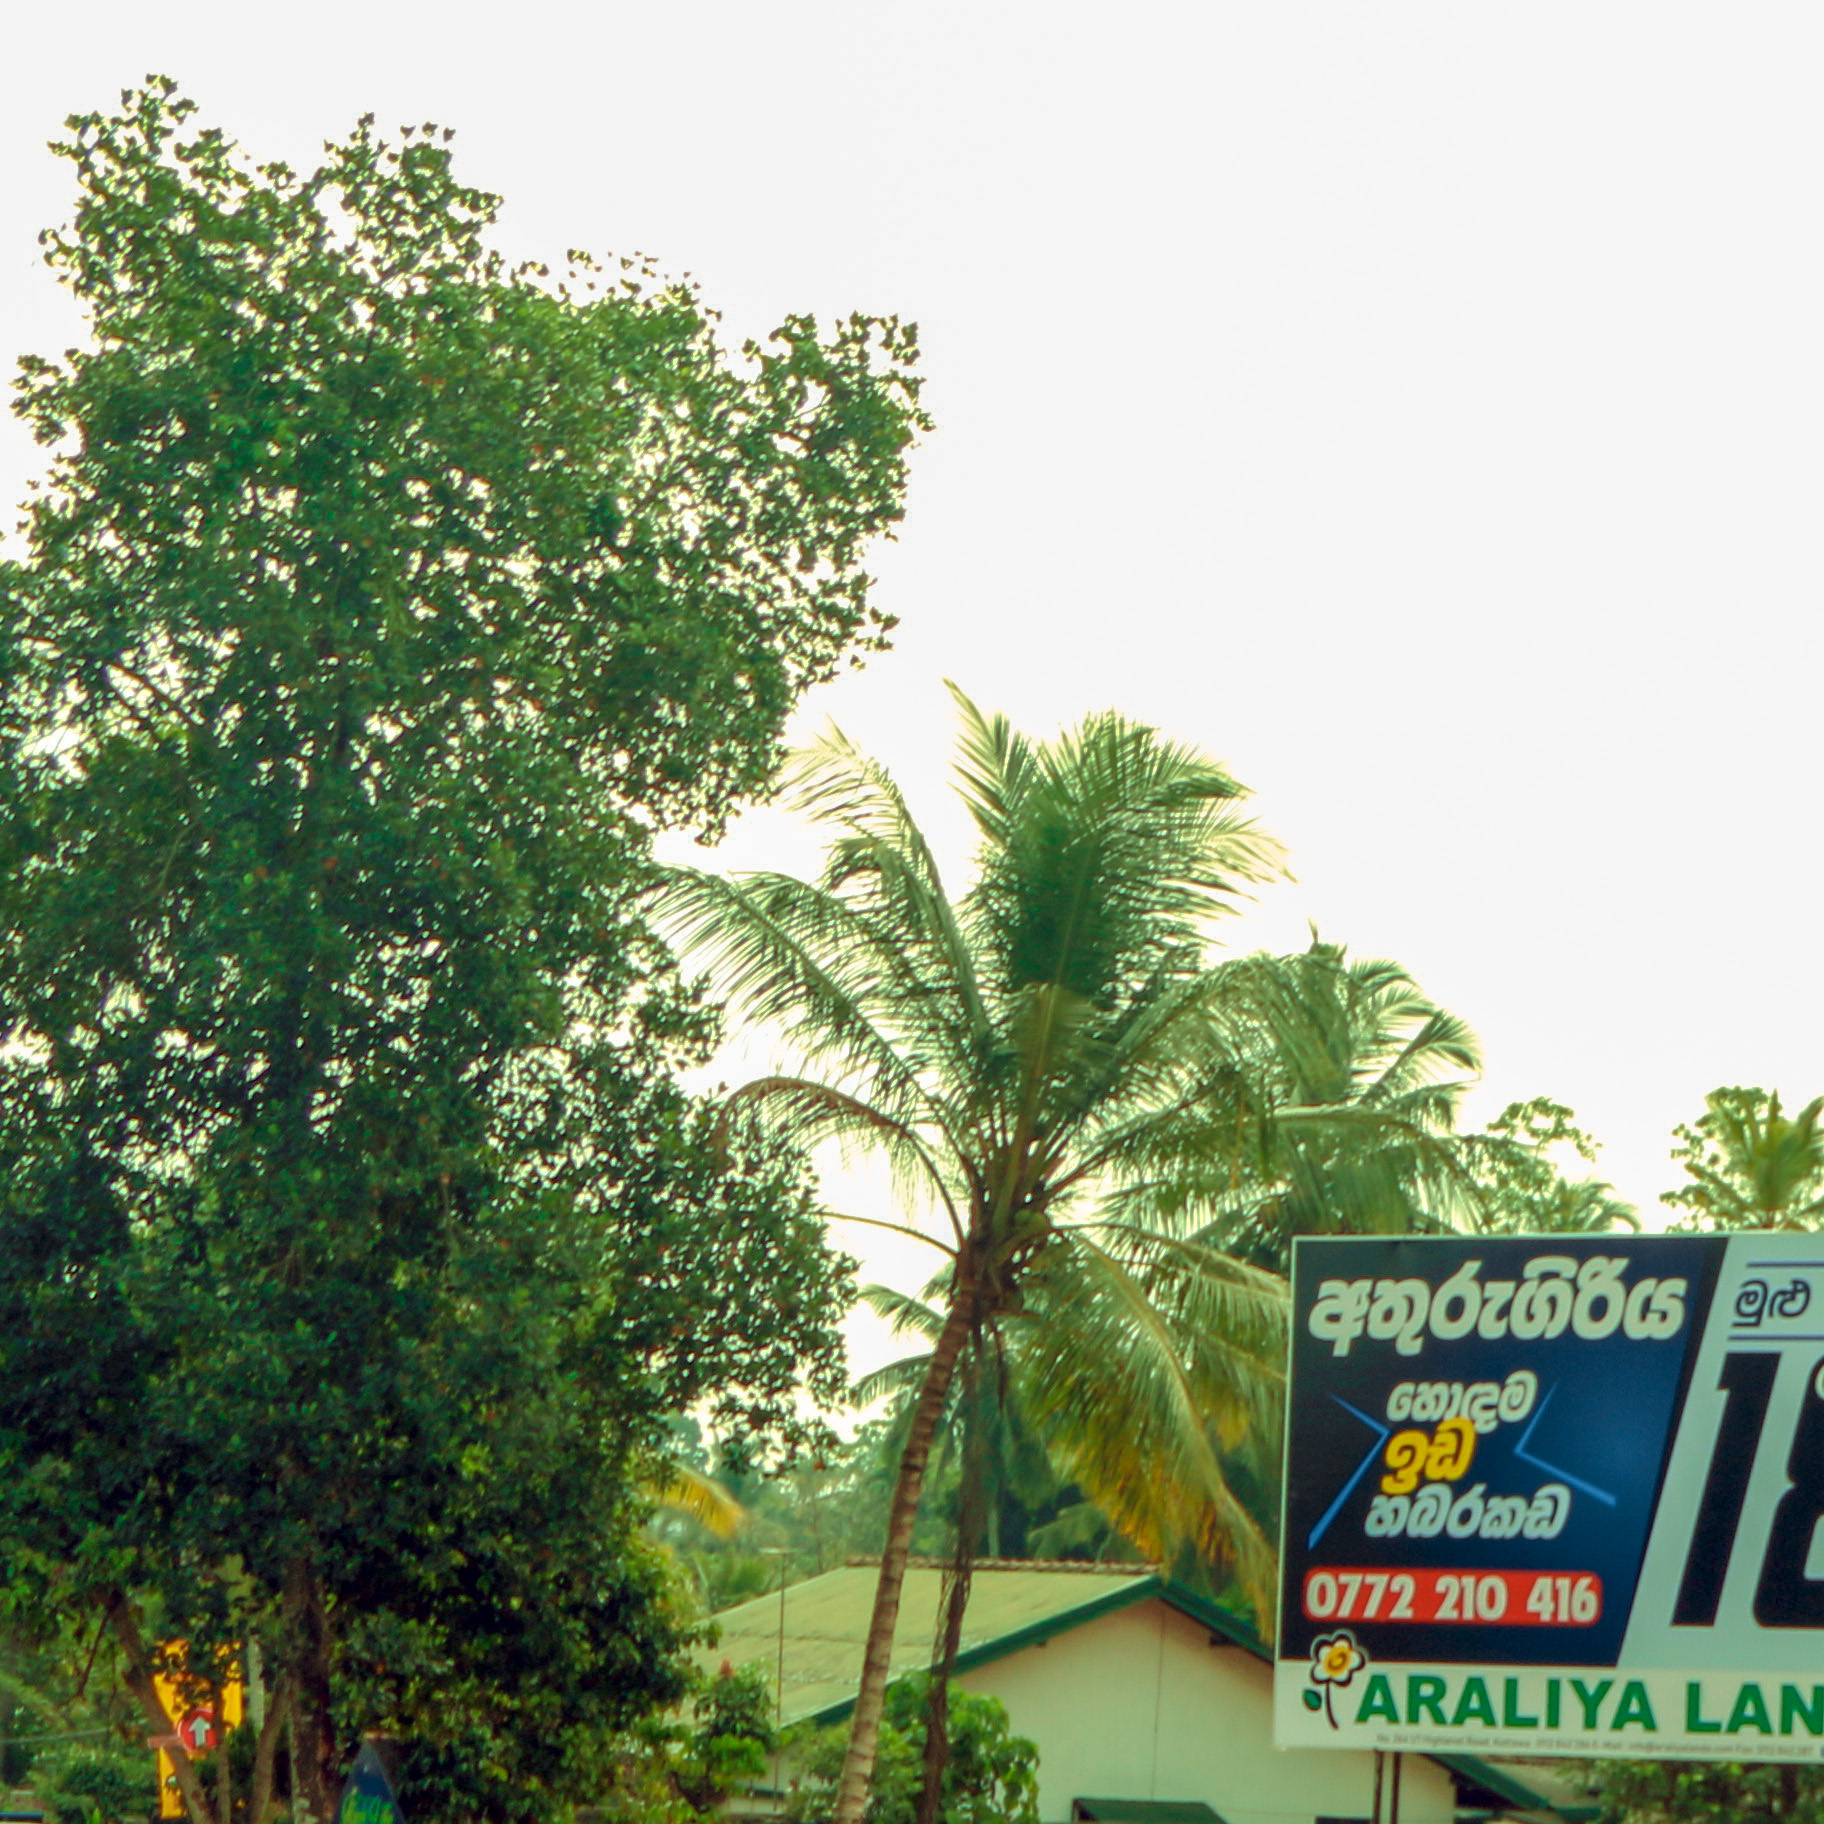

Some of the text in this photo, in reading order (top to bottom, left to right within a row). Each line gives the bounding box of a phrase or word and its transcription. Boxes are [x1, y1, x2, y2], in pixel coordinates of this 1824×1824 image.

[1308, 1255, 1688, 1357] අතුරුගිරිය
[1731, 1277, 1812, 1328] මුළු
[1386, 1369, 1539, 1434] හොඳම
[1380, 1416, 1477, 1494] ඉඩ
[1305, 1574, 1597, 1624] 0772 210 416
[1355, 1674, 1657, 1731] ARALIYA
